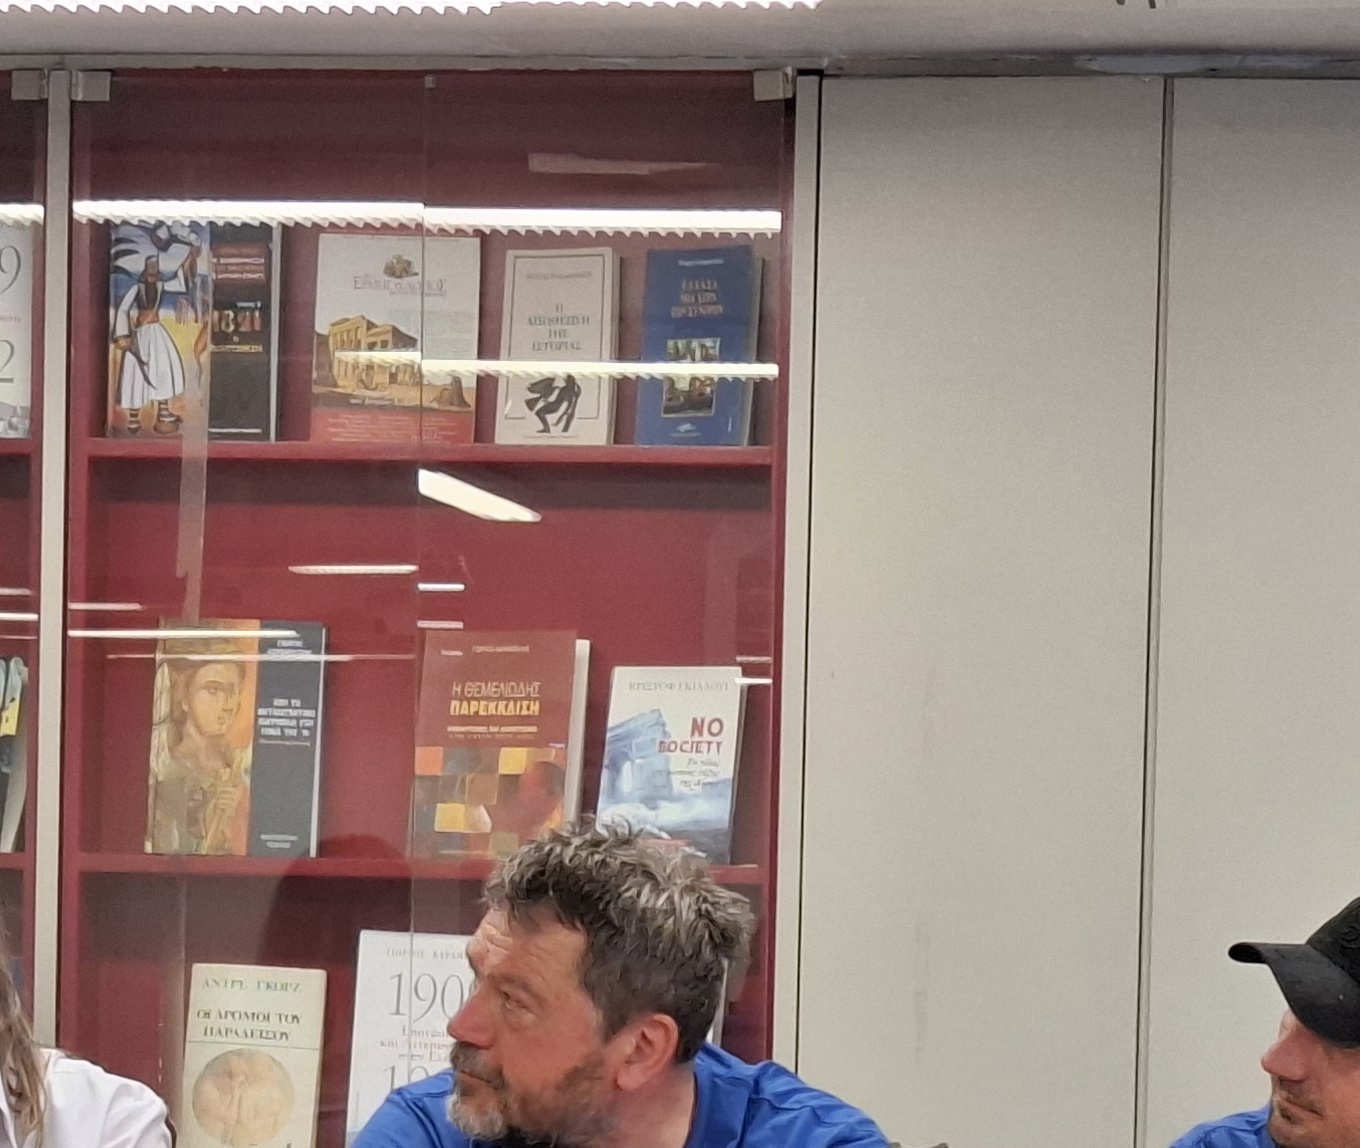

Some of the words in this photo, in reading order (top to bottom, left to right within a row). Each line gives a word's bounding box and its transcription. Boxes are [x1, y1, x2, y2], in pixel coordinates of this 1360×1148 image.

[451, 681, 461, 697] Η
[450, 699, 541, 716] ΠΑΡΕΚΚΛΙΣΗ
[690, 717, 725, 738] NO
[658, 740, 724, 755] SOCIETY
[389, 971, 474, 1024] 190
